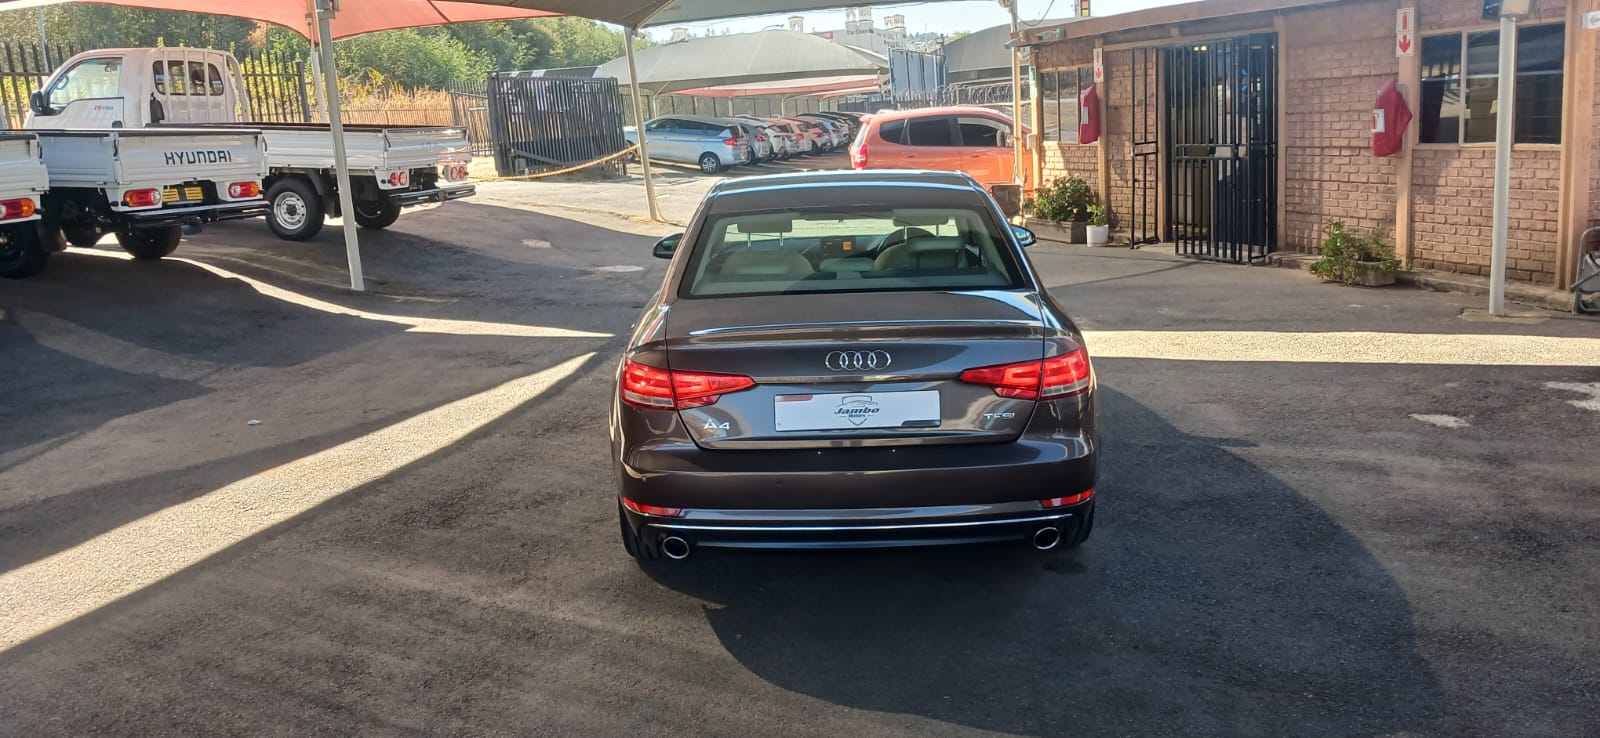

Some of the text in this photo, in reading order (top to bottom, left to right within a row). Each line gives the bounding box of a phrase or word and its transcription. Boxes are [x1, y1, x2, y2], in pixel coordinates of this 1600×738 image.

[164, 150, 232, 165] HYUNDAI
[834, 406, 880, 415] Jambo
[703, 418, 730, 430] A4
